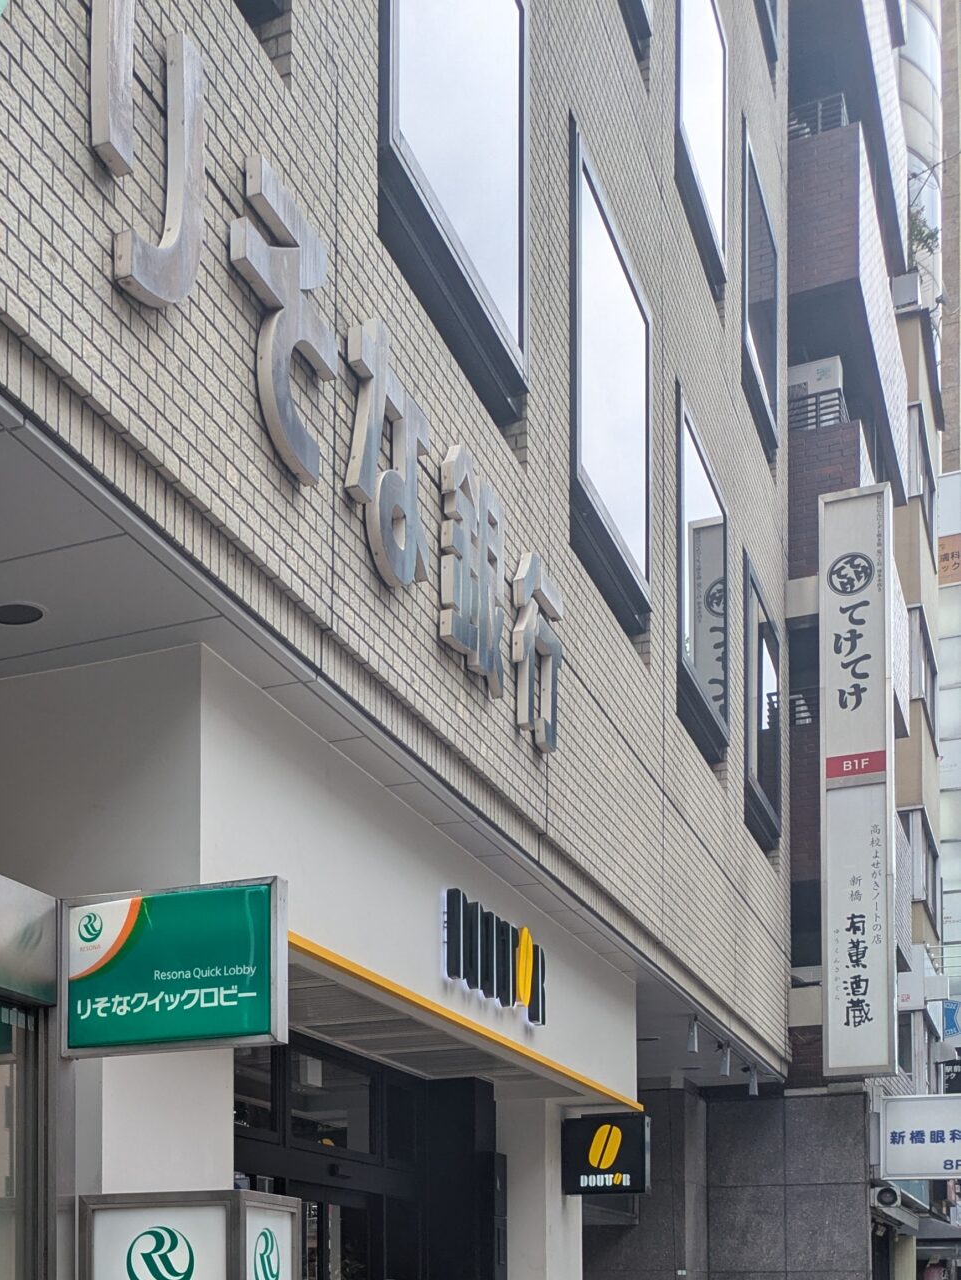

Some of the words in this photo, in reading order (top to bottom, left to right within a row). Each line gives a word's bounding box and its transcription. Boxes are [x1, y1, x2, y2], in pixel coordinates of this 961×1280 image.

[90, 0, 563, 754] りそな銀行
[833, 600, 872, 711] てけてけ
[843, 758, 870, 771] B1F
[850, 875, 862, 902] 新橋
[870, 824, 882, 945] 高校よせがきノートの店
[80, 943, 101, 952] RESONA
[154, 969, 190, 981] Resona
[193, 966, 222, 979] Quick
[224, 964, 257, 977] Lobby
[77, 985, 257, 1020] りそなクイックロビー
[580, 1173, 631, 1187] DOUTOR
